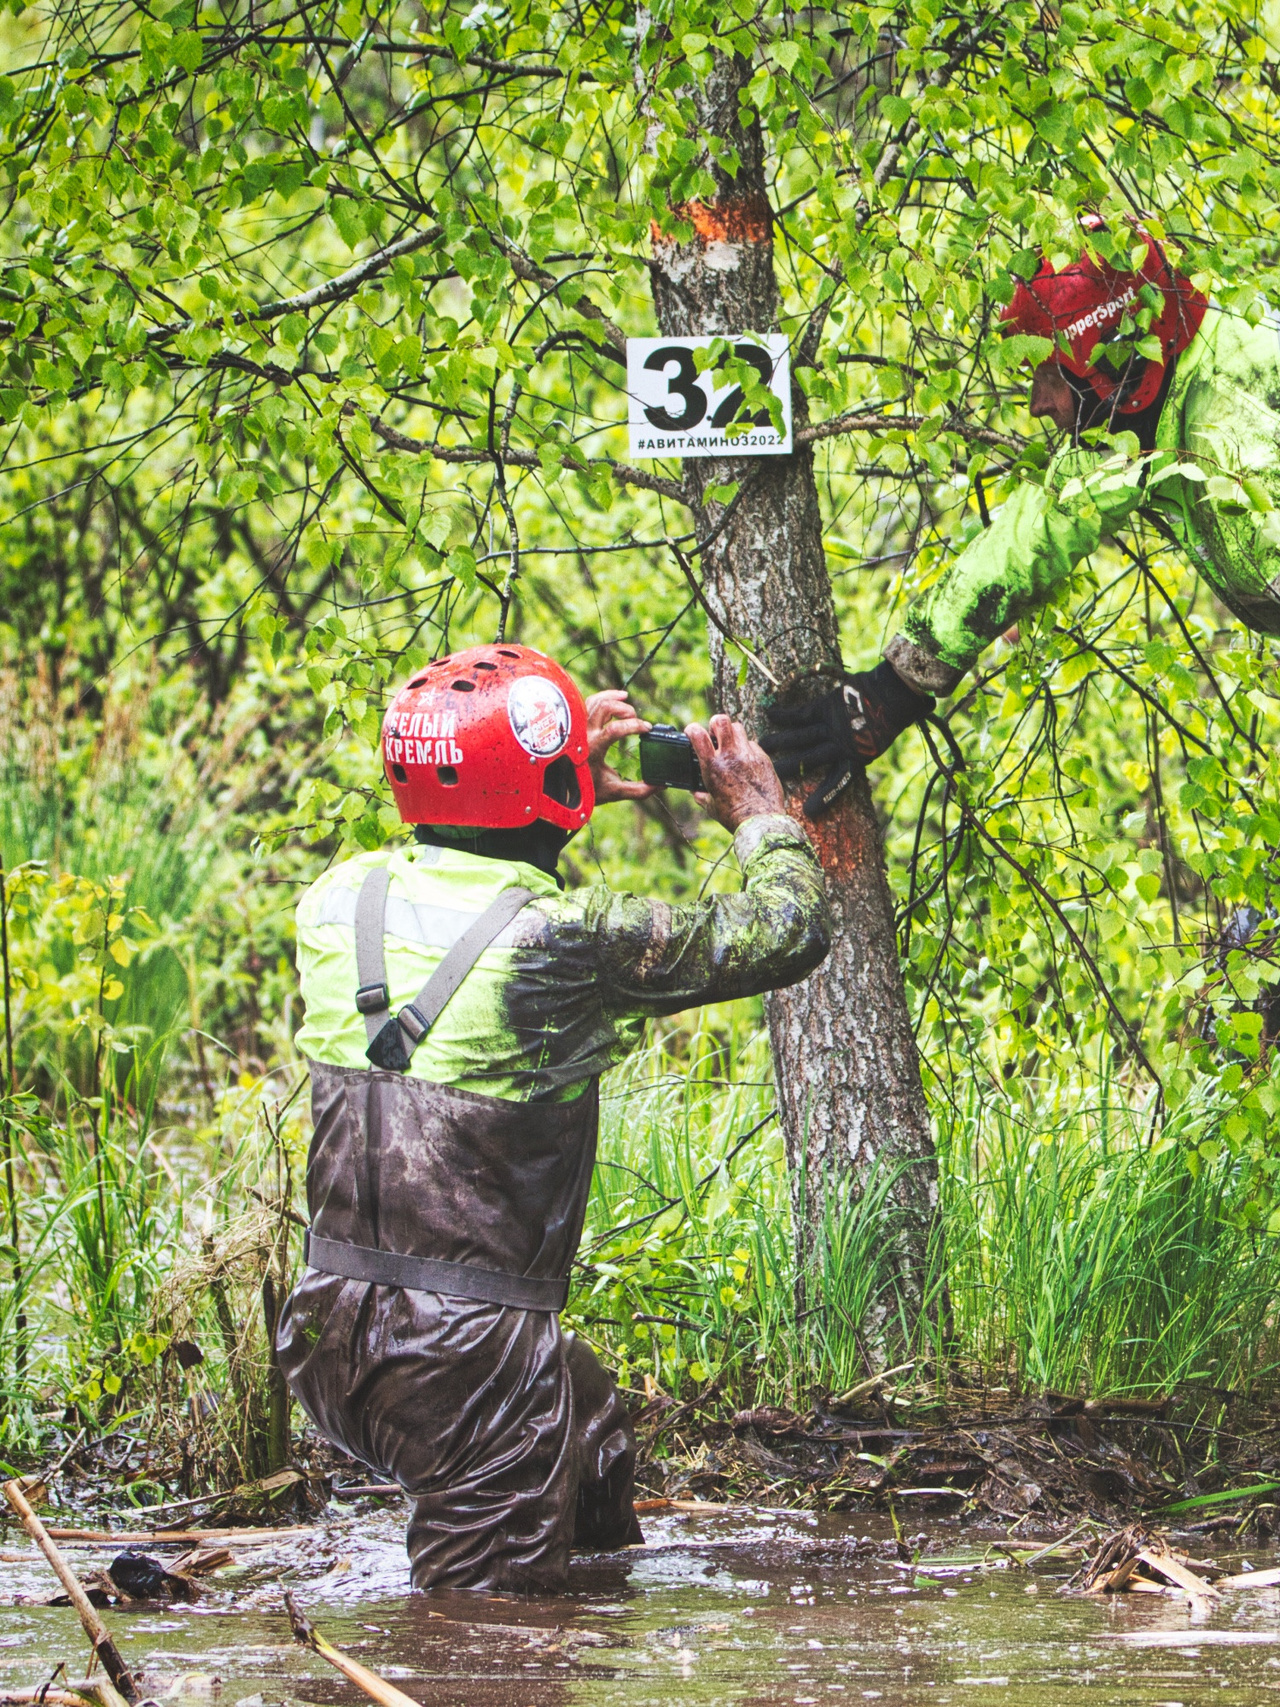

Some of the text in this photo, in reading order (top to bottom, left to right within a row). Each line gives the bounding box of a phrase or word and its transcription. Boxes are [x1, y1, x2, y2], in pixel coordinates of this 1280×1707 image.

[643, 344, 774, 431] 32
[389, 709, 457, 738] БЕЛЫЙ
[385, 736, 464, 765] КРЕМЛЬ
